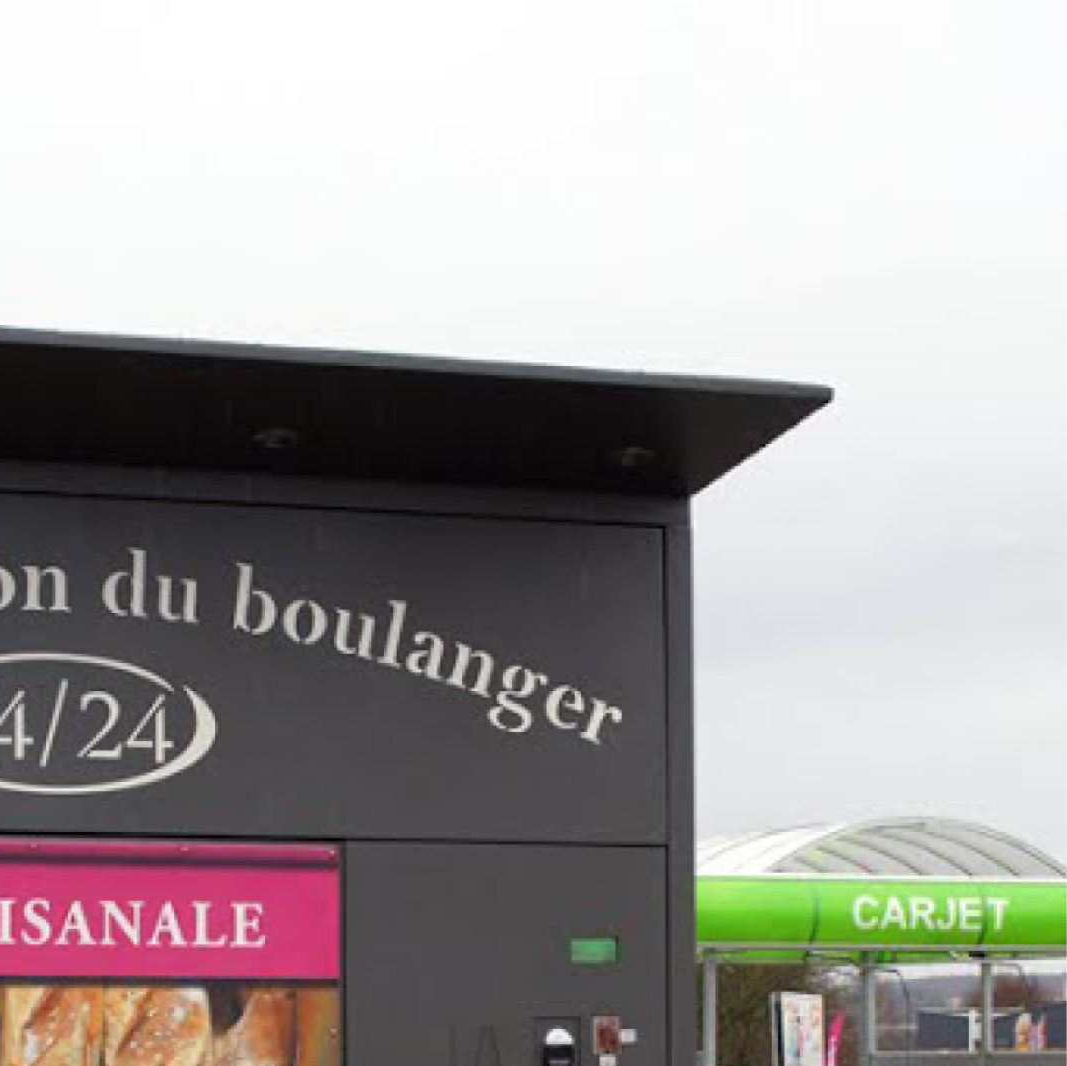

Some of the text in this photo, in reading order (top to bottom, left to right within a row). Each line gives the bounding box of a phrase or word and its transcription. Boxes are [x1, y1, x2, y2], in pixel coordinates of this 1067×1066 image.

[101, 548, 200, 624] du
[234, 562, 623, 745] boulanger
[852, 894, 1009, 931] CARJET
